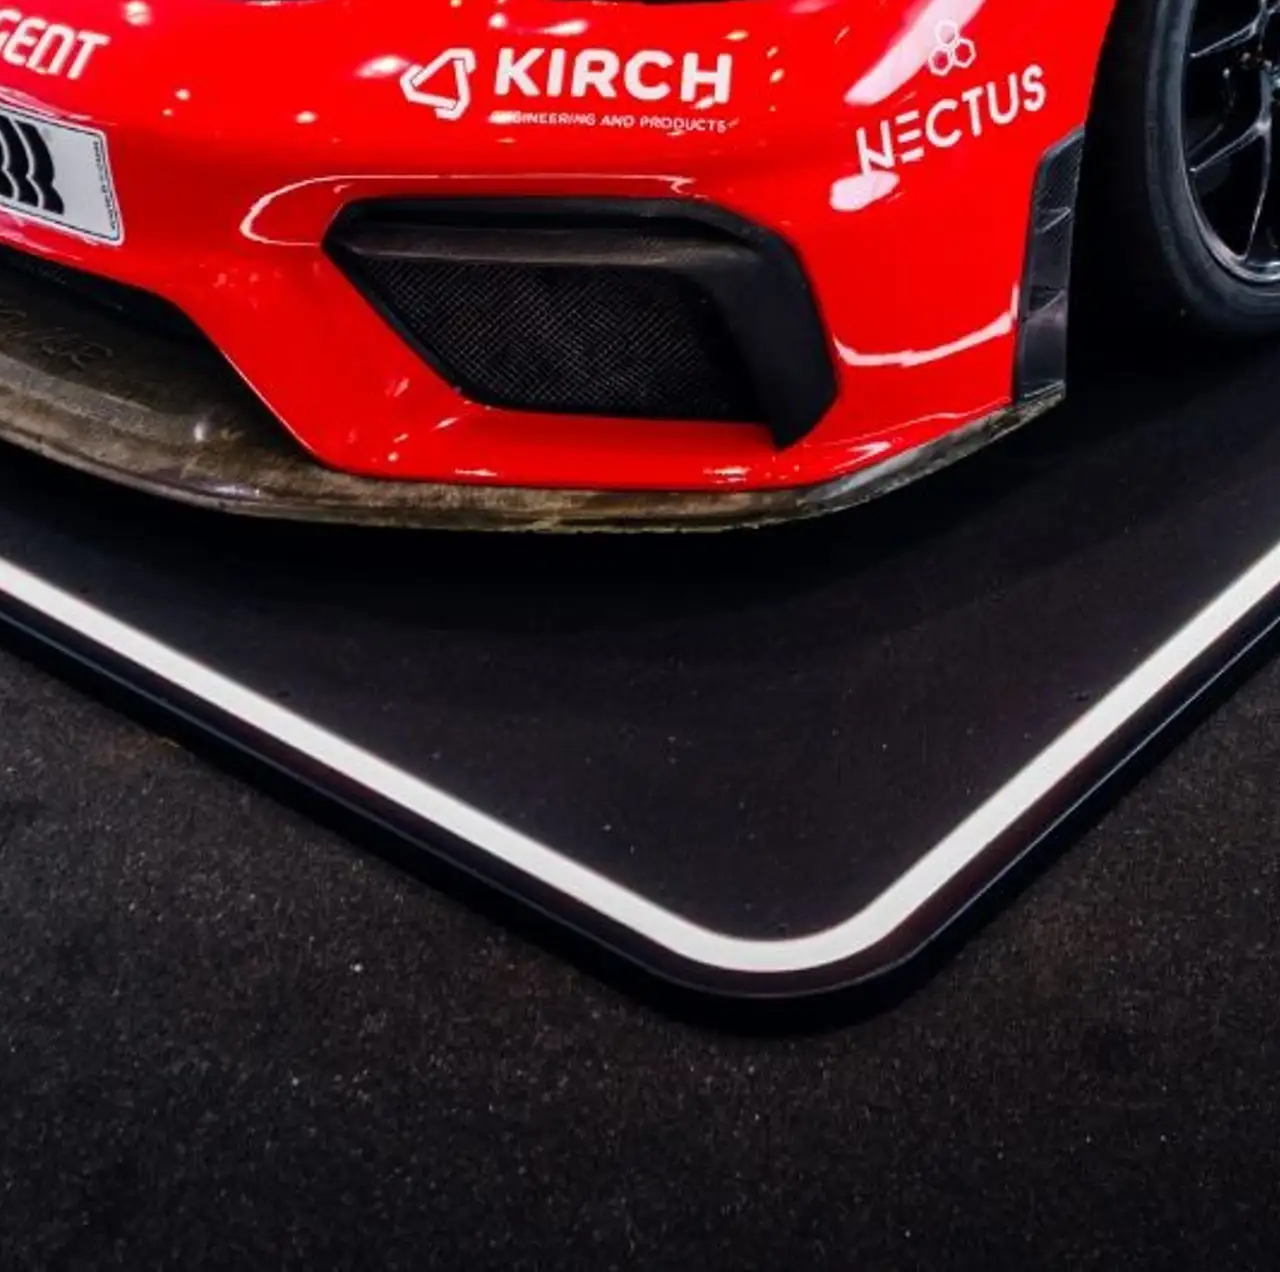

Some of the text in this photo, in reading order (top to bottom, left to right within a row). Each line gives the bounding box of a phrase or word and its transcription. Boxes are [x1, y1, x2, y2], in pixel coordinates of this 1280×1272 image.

[494, 47, 733, 104] KIRCH
[599, 114, 635, 128] AND
[639, 115, 727, 133] PRODUCTS
[856, 64, 1047, 178] NECTUS
